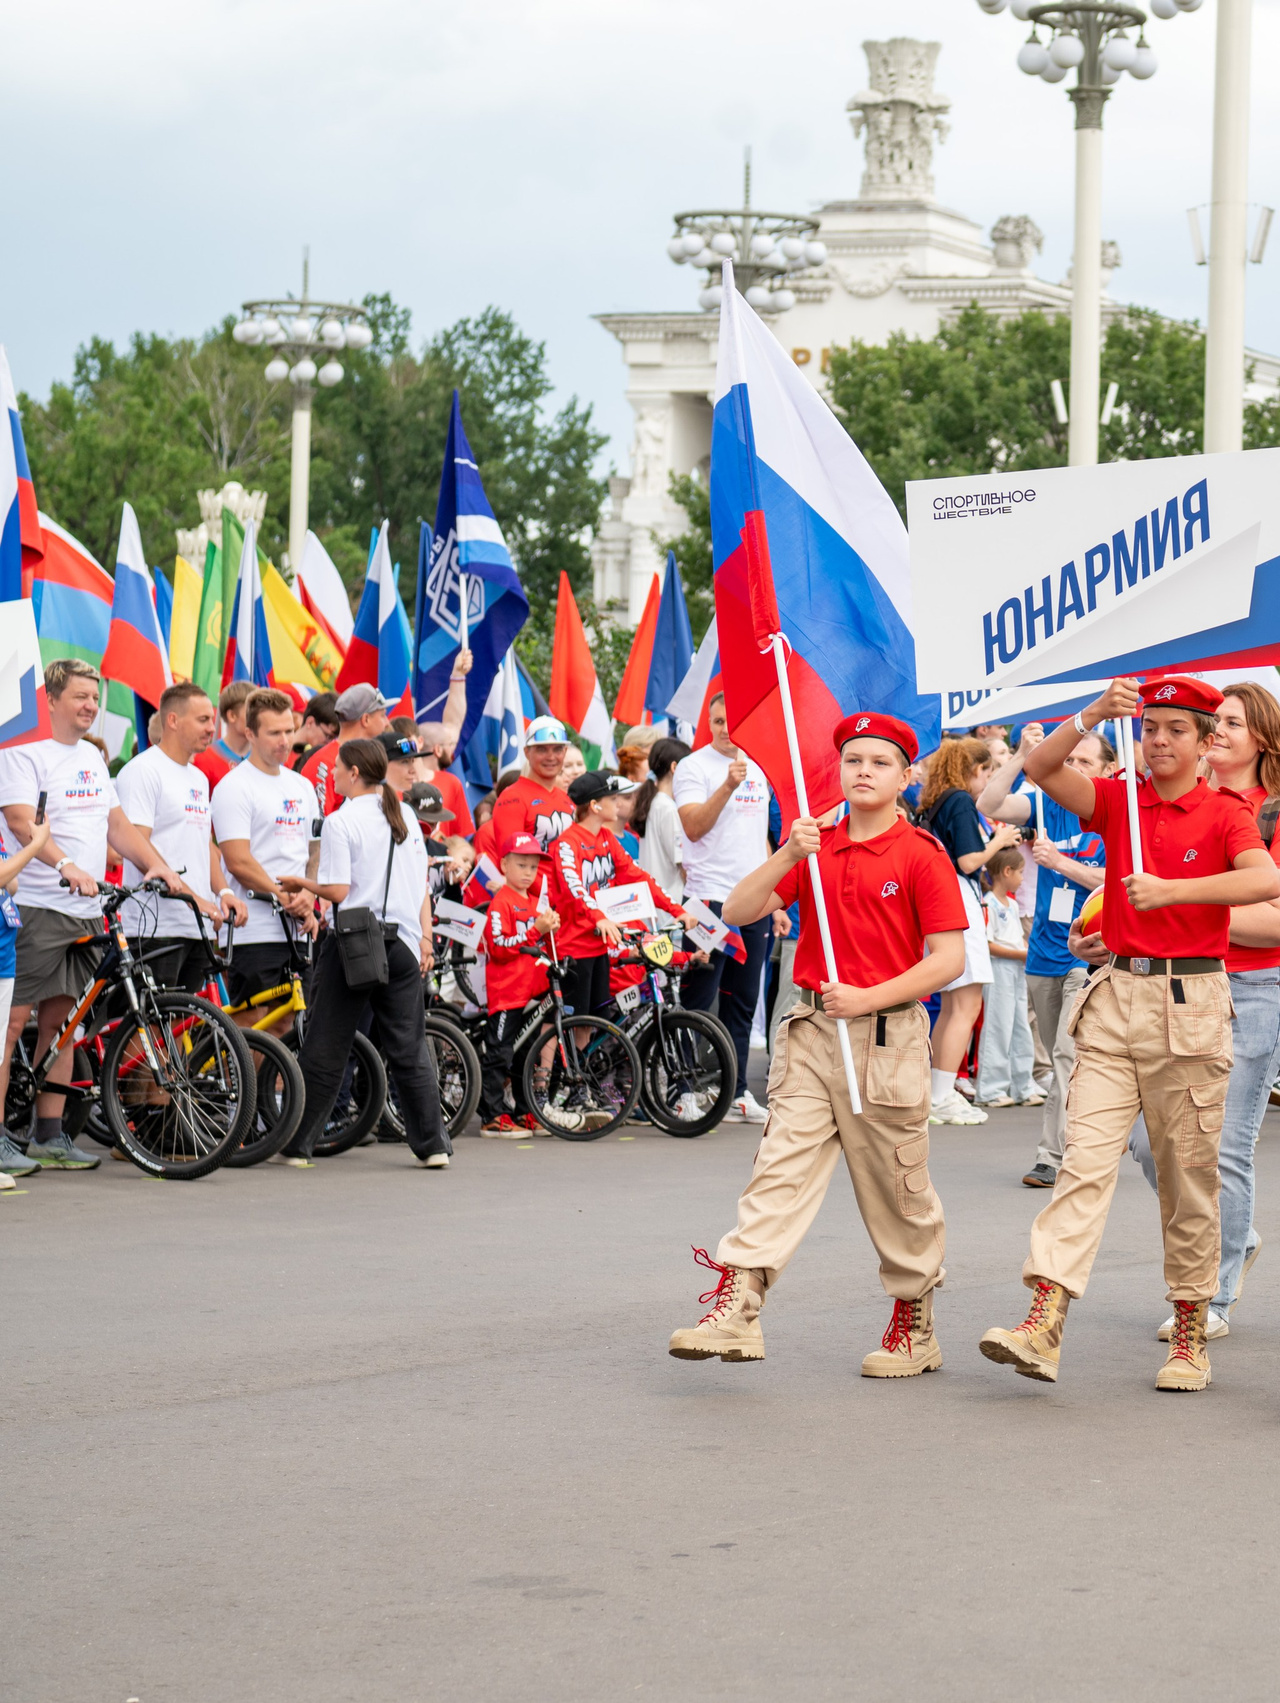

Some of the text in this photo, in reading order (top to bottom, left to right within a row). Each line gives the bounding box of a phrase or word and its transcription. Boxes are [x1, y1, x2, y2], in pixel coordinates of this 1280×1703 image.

[933, 505, 1013, 520] ШЕСТВИЕ
[982, 477, 1211, 676] ЮНАРМИЯ
[623, 989, 637, 1004] 115
